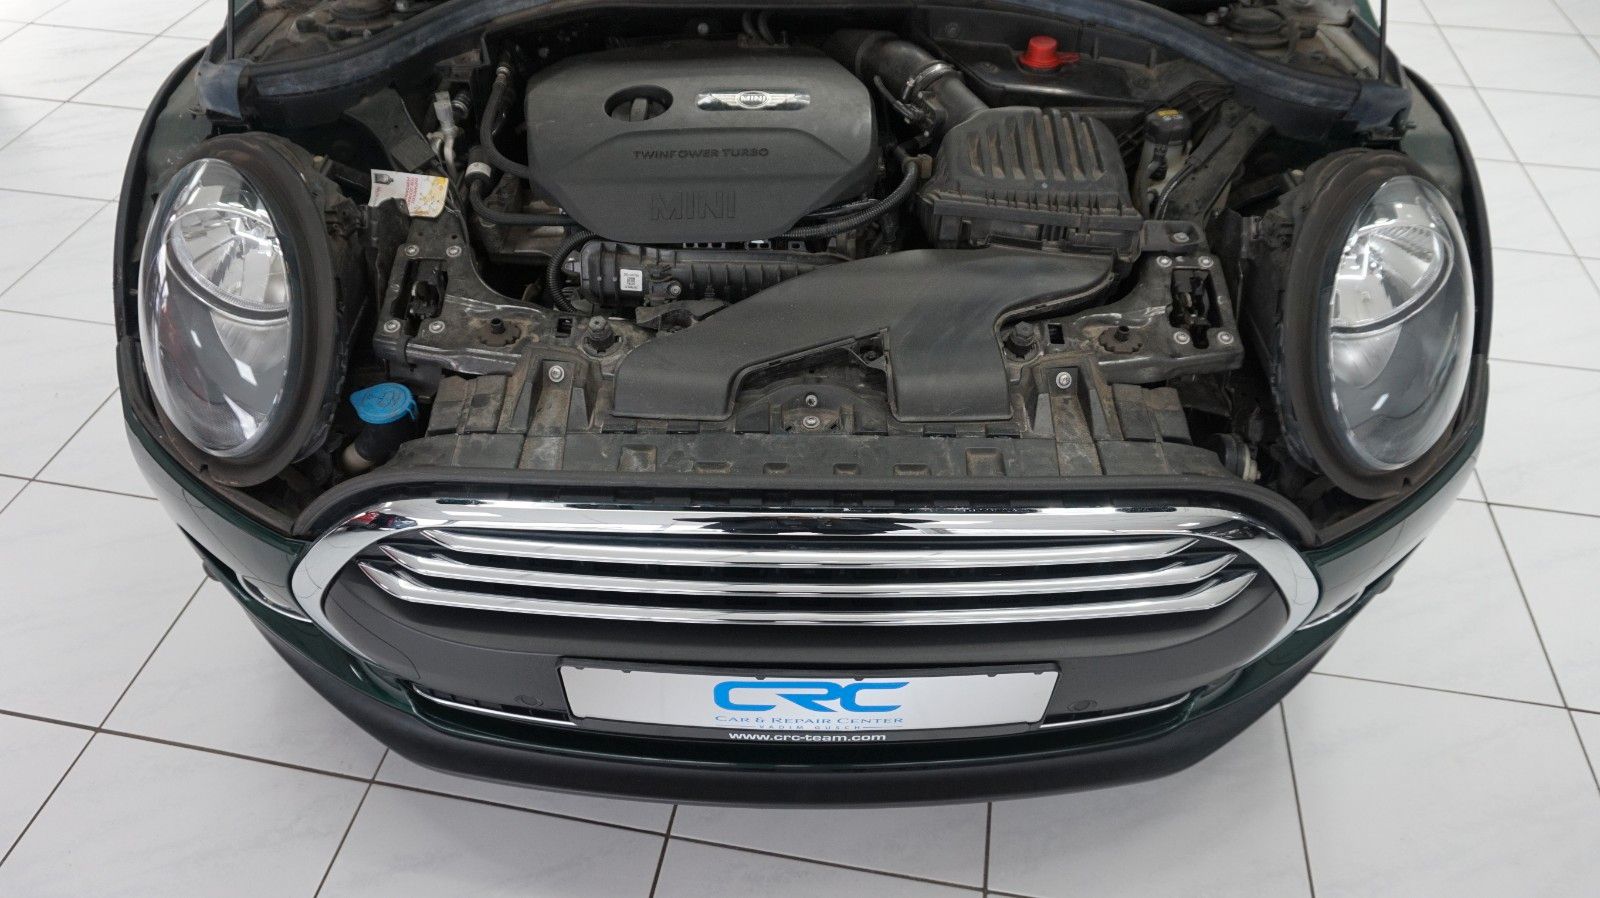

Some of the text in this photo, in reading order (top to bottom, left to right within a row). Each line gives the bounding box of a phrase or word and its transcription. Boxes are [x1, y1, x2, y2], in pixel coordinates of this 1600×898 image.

[740, 94, 766, 103] MINI
[721, 147, 769, 158] TURBO
[650, 191, 736, 220] MINI
[713, 681, 910, 712] CRC
[728, 733, 887, 742] www.crc-team.com
